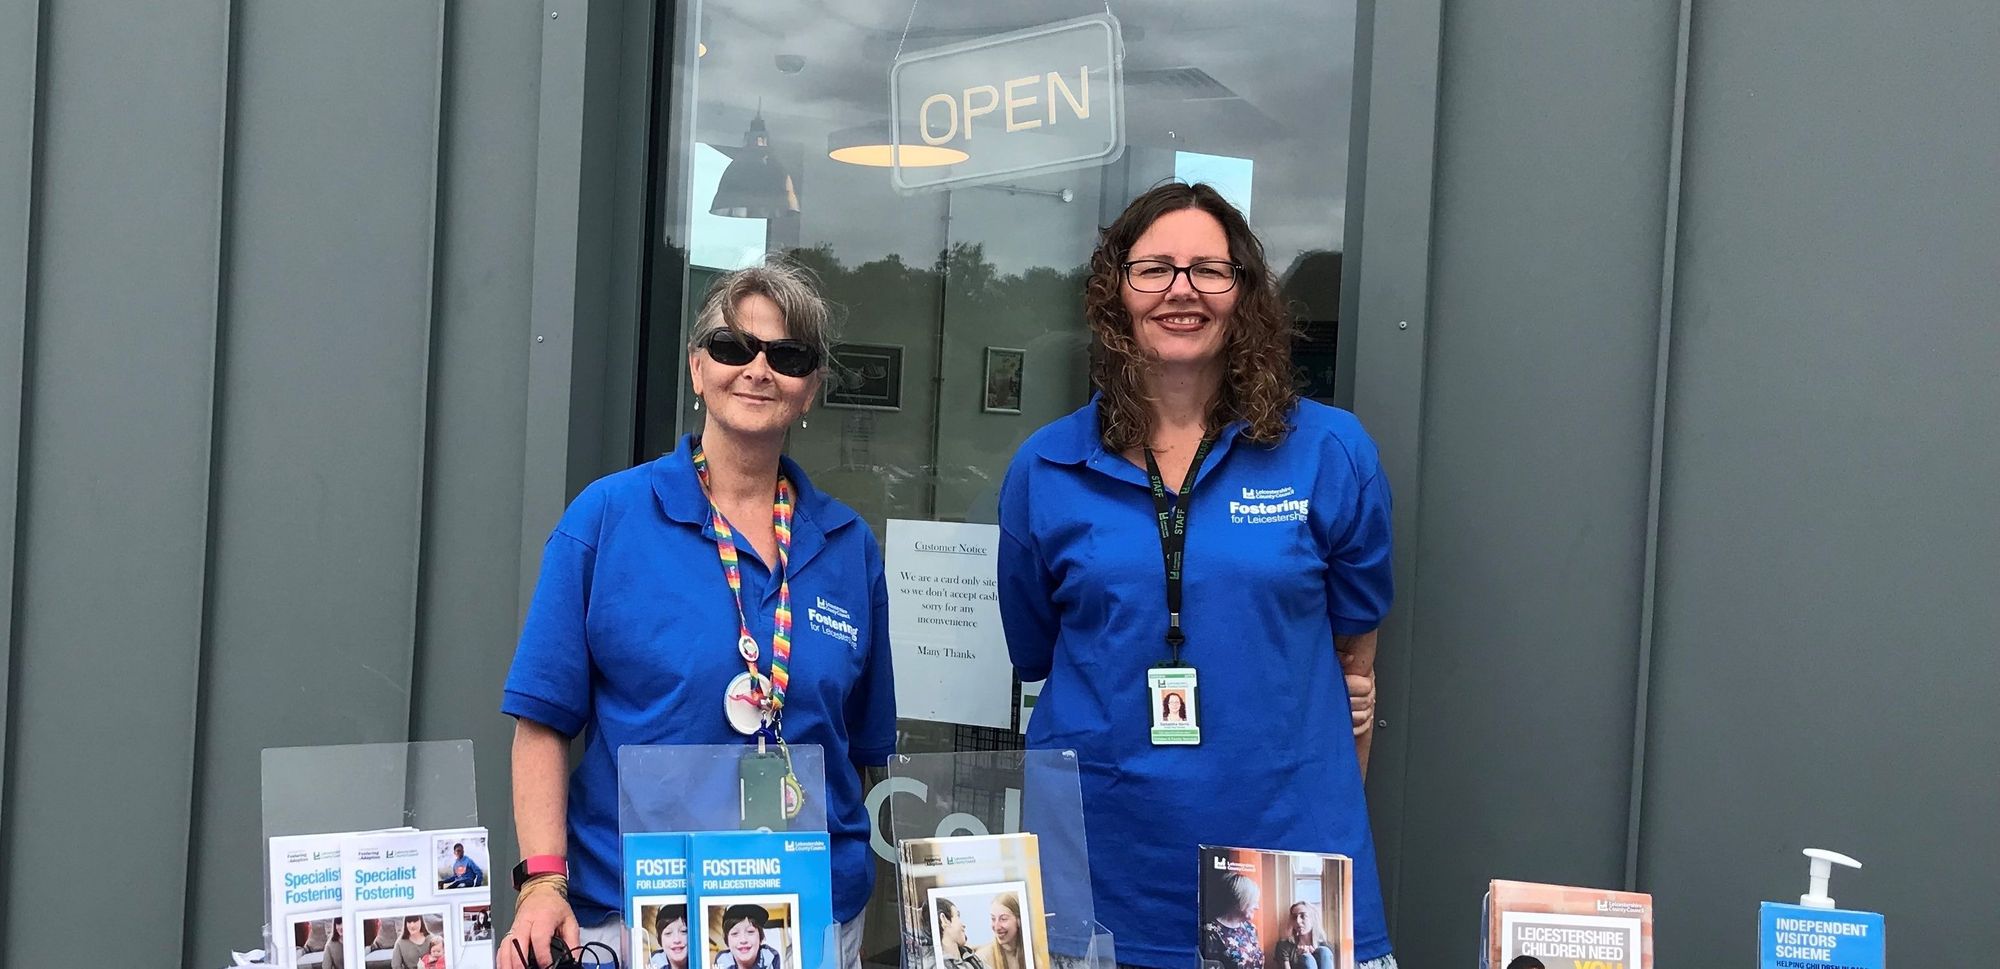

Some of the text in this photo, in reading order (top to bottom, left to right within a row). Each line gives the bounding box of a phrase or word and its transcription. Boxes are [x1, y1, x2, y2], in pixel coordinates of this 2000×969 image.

[919, 64, 1090, 146] OPEN
[1151, 475, 1164, 498] STAFF
[1229, 499, 1309, 515] Fostering
[1174, 508, 1185, 535] STAFF
[1231, 514, 1244, 523] for
[914, 541, 988, 554] Customer Notice
[900, 571, 916, 582] We
[941, 576, 959, 584] card
[961, 576, 980, 586] only
[982, 577, 997, 587] site
[926, 587, 948, 597] don't
[950, 591, 977, 601] accept
[979, 592, 998, 601] cash
[921, 603, 974, 615] sorry for any
[808, 608, 859, 641] Fostering
[810, 621, 820, 632] for
[917, 616, 978, 628] inconvenience
[918, 645, 976, 659] Many Thanks
[702, 858, 781, 876] FOSTERING
[355, 866, 417, 886] Specialist
[703, 878, 781, 890] FOR LEICESTERSHIRE
[355, 883, 415, 901] Fostering
[636, 880, 652, 890] FOR
[285, 885, 343, 904] Fostering
[1775, 917, 1868, 937] INDEPENDENT
[1517, 926, 1624, 946] LEICESTERSHIRE
[1775, 931, 1837, 948] VISITORS
[1521, 941, 1624, 961] CHILDREN NEED
[1775, 945, 1831, 962] SCHEME
[1776, 960, 1804, 968] HELPING
